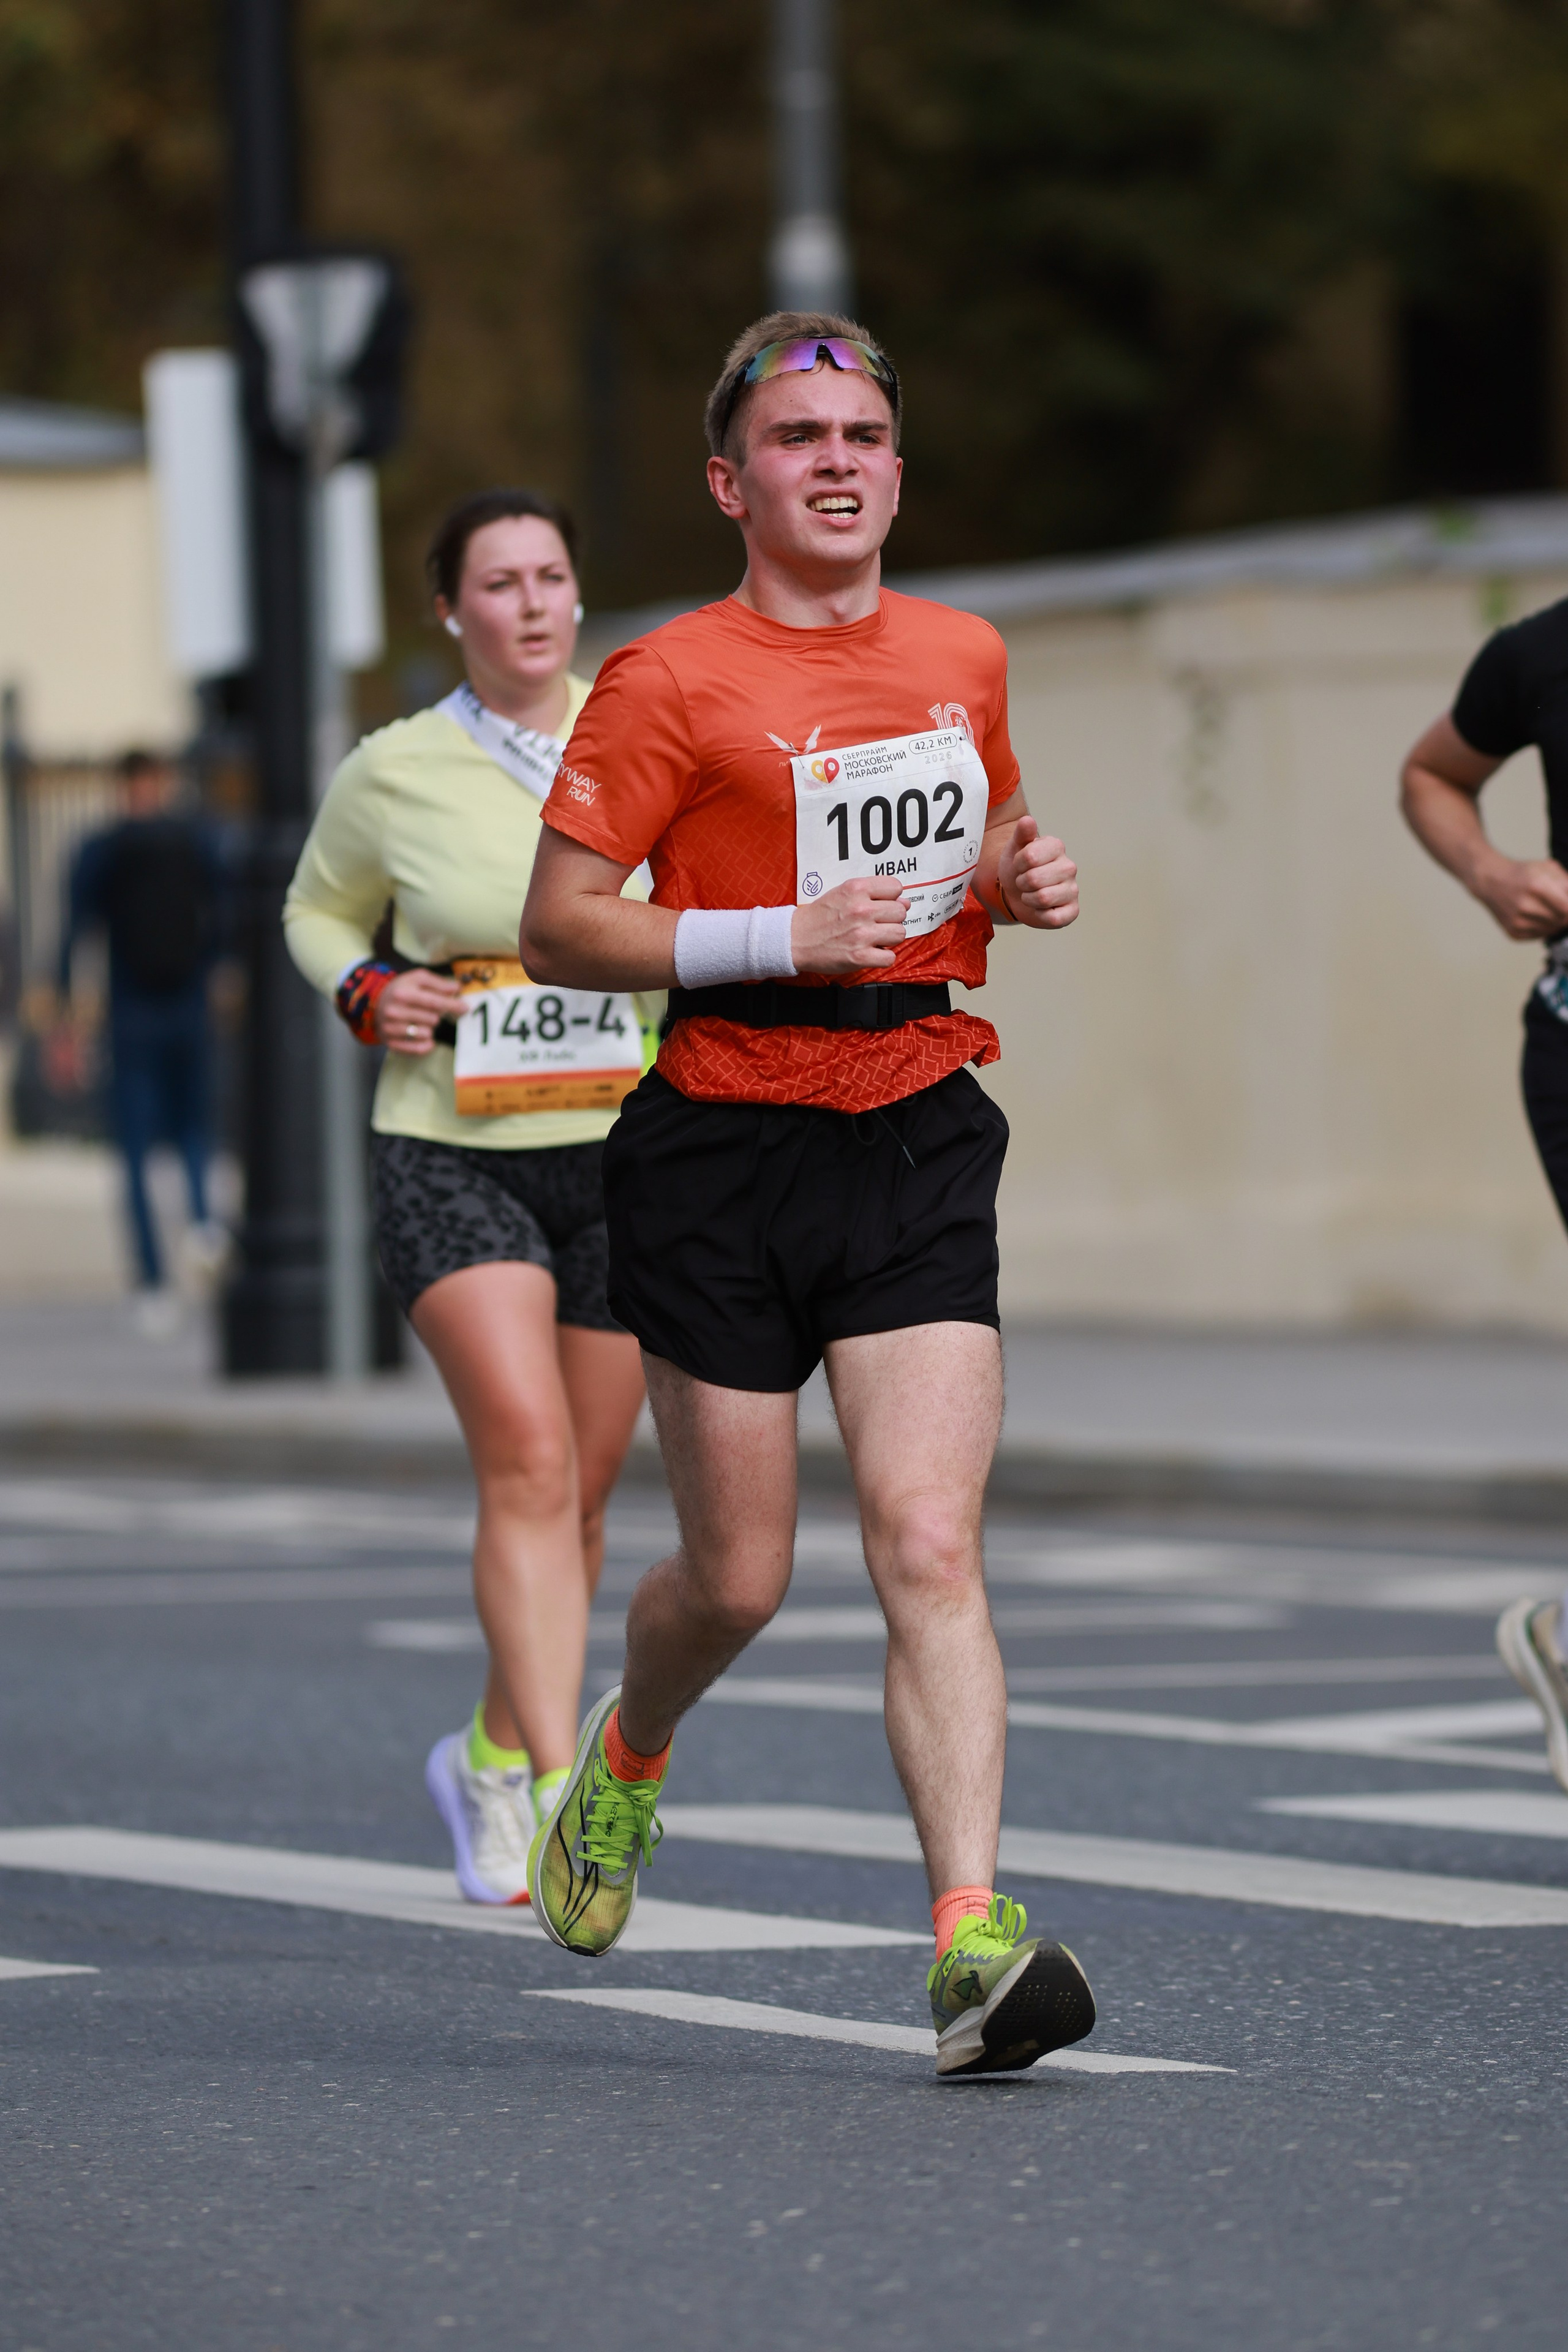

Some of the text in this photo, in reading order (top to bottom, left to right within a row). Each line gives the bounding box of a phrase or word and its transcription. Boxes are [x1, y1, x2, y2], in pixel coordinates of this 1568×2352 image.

[914, 739, 935, 750] 42,2
[842, 746, 888, 761] СБЕРПРАЙМ
[844, 749, 907, 771] МОСКОВСКИЙ
[924, 750, 952, 764] 2026
[846, 763, 894, 780] МАРАФОН
[566, 785, 595, 807] RUN
[827, 781, 965, 861] 1002
[968, 847, 973, 856] 1
[875, 856, 917, 876] ИВАН
[902, 917, 922, 926] агнит
[472, 995, 625, 1045] 148-4
